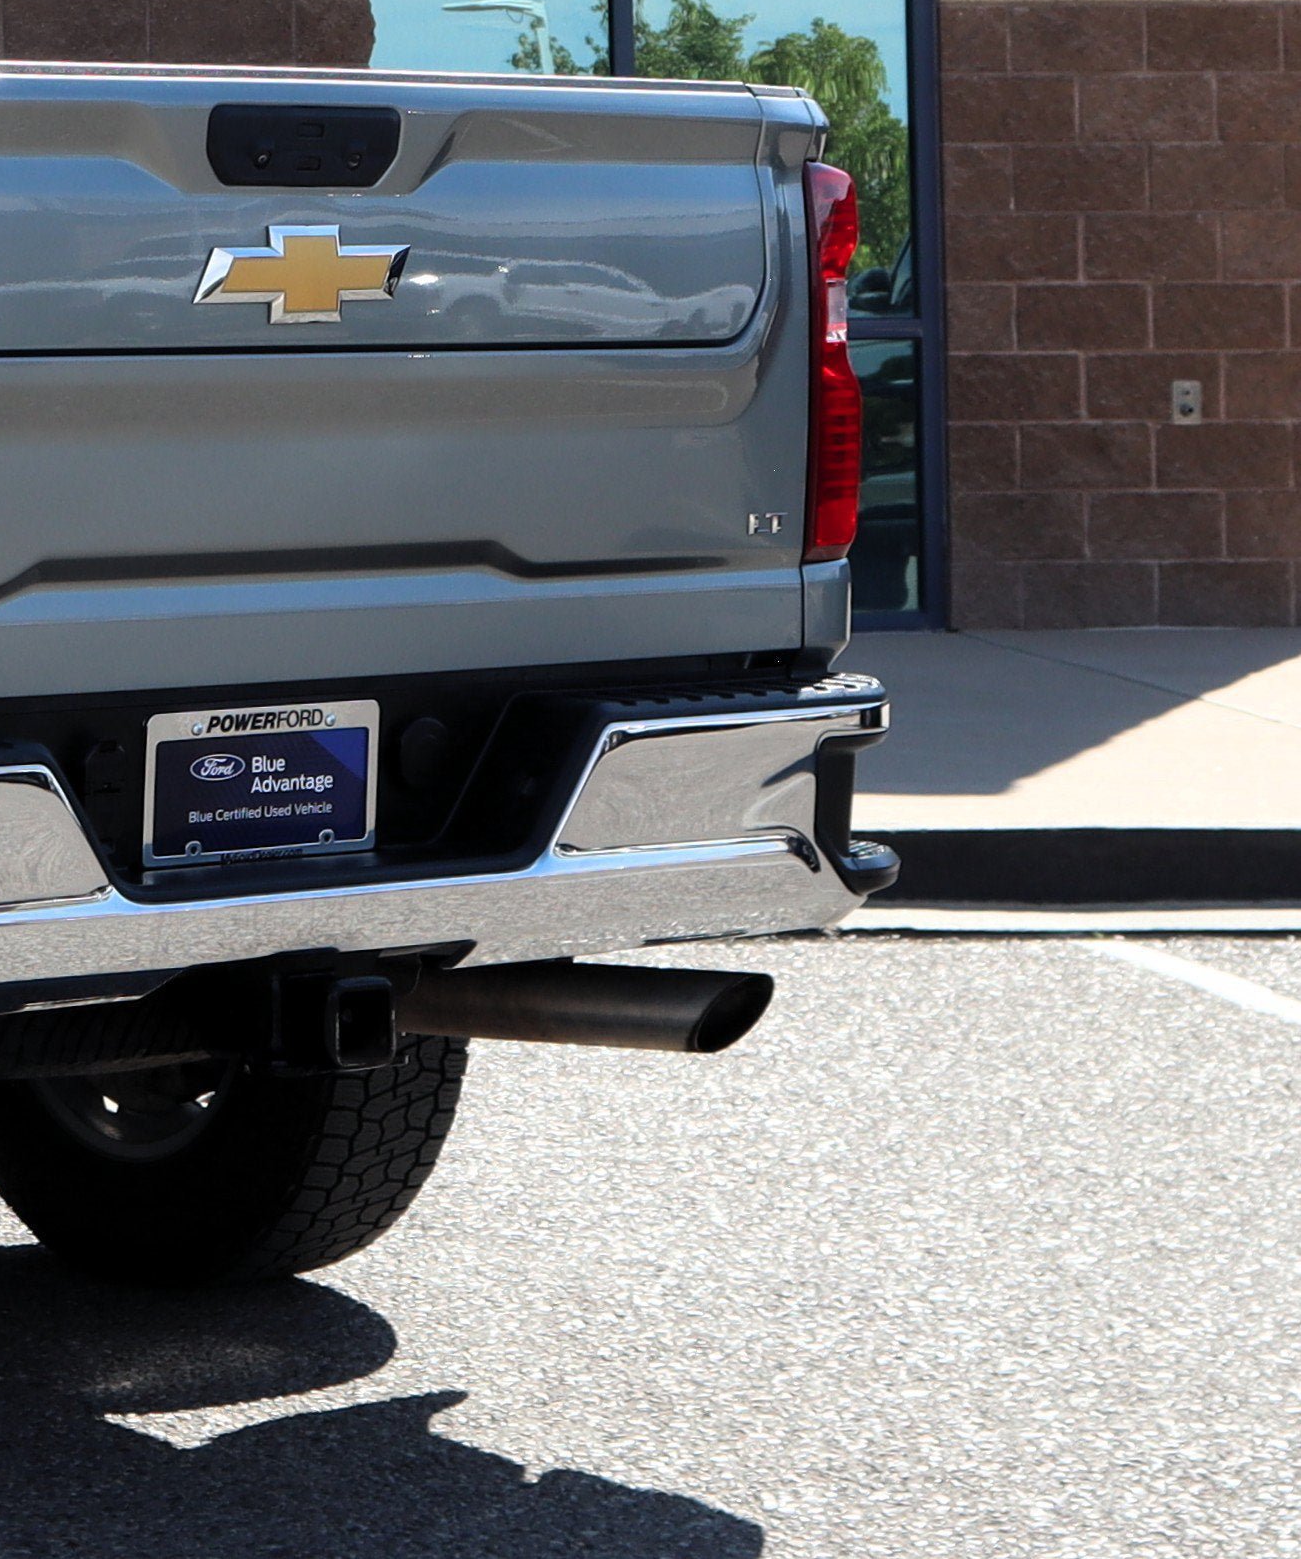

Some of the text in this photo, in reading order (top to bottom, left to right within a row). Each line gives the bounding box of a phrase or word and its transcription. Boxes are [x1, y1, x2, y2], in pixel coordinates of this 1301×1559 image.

[747, 512, 789, 535] LT
[206, 709, 323, 733] POWERFORD
[200, 758, 235, 776] Ford
[251, 756, 286, 773] Blue
[250, 774, 334, 794] Advantage
[188, 801, 333, 823] Blue Certified Used Vehicle
